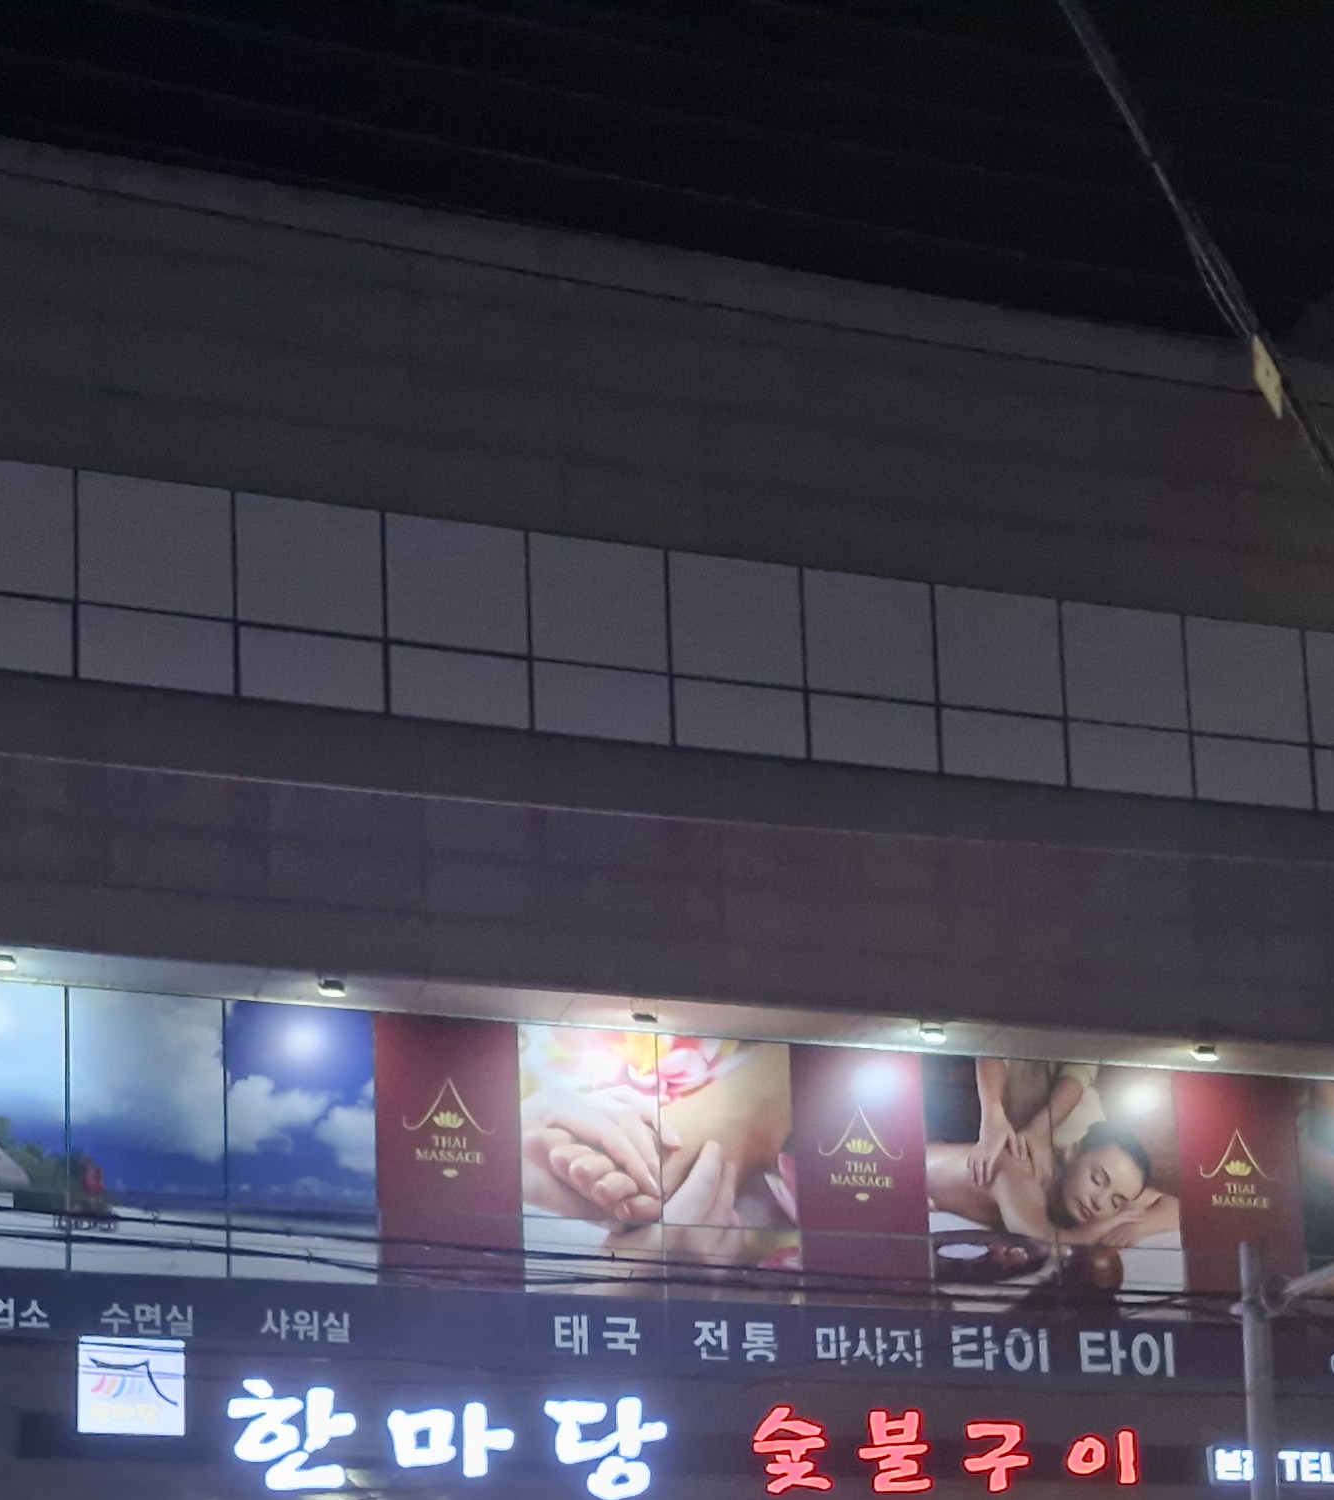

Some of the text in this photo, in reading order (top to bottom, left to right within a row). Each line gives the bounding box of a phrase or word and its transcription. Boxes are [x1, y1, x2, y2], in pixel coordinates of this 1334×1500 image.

[431, 1134, 467, 1150] THAI
[415, 1147, 484, 1164] MASSAGE
[844, 1160, 877, 1174] THAI
[830, 1172, 893, 1189] MASSAGE
[1224, 1182, 1256, 1195] THAI
[100, 1302, 195, 1338] 수면실
[260, 1309, 352, 1343] 샤워실
[815, 1325, 923, 1369] 마사지
[950, 1324, 1050, 1373] 타이
[1078, 1329, 1176, 1378] 타이
[226, 1378, 669, 1500] 한마당
[752, 1405, 1140, 1495] 숯불구이
